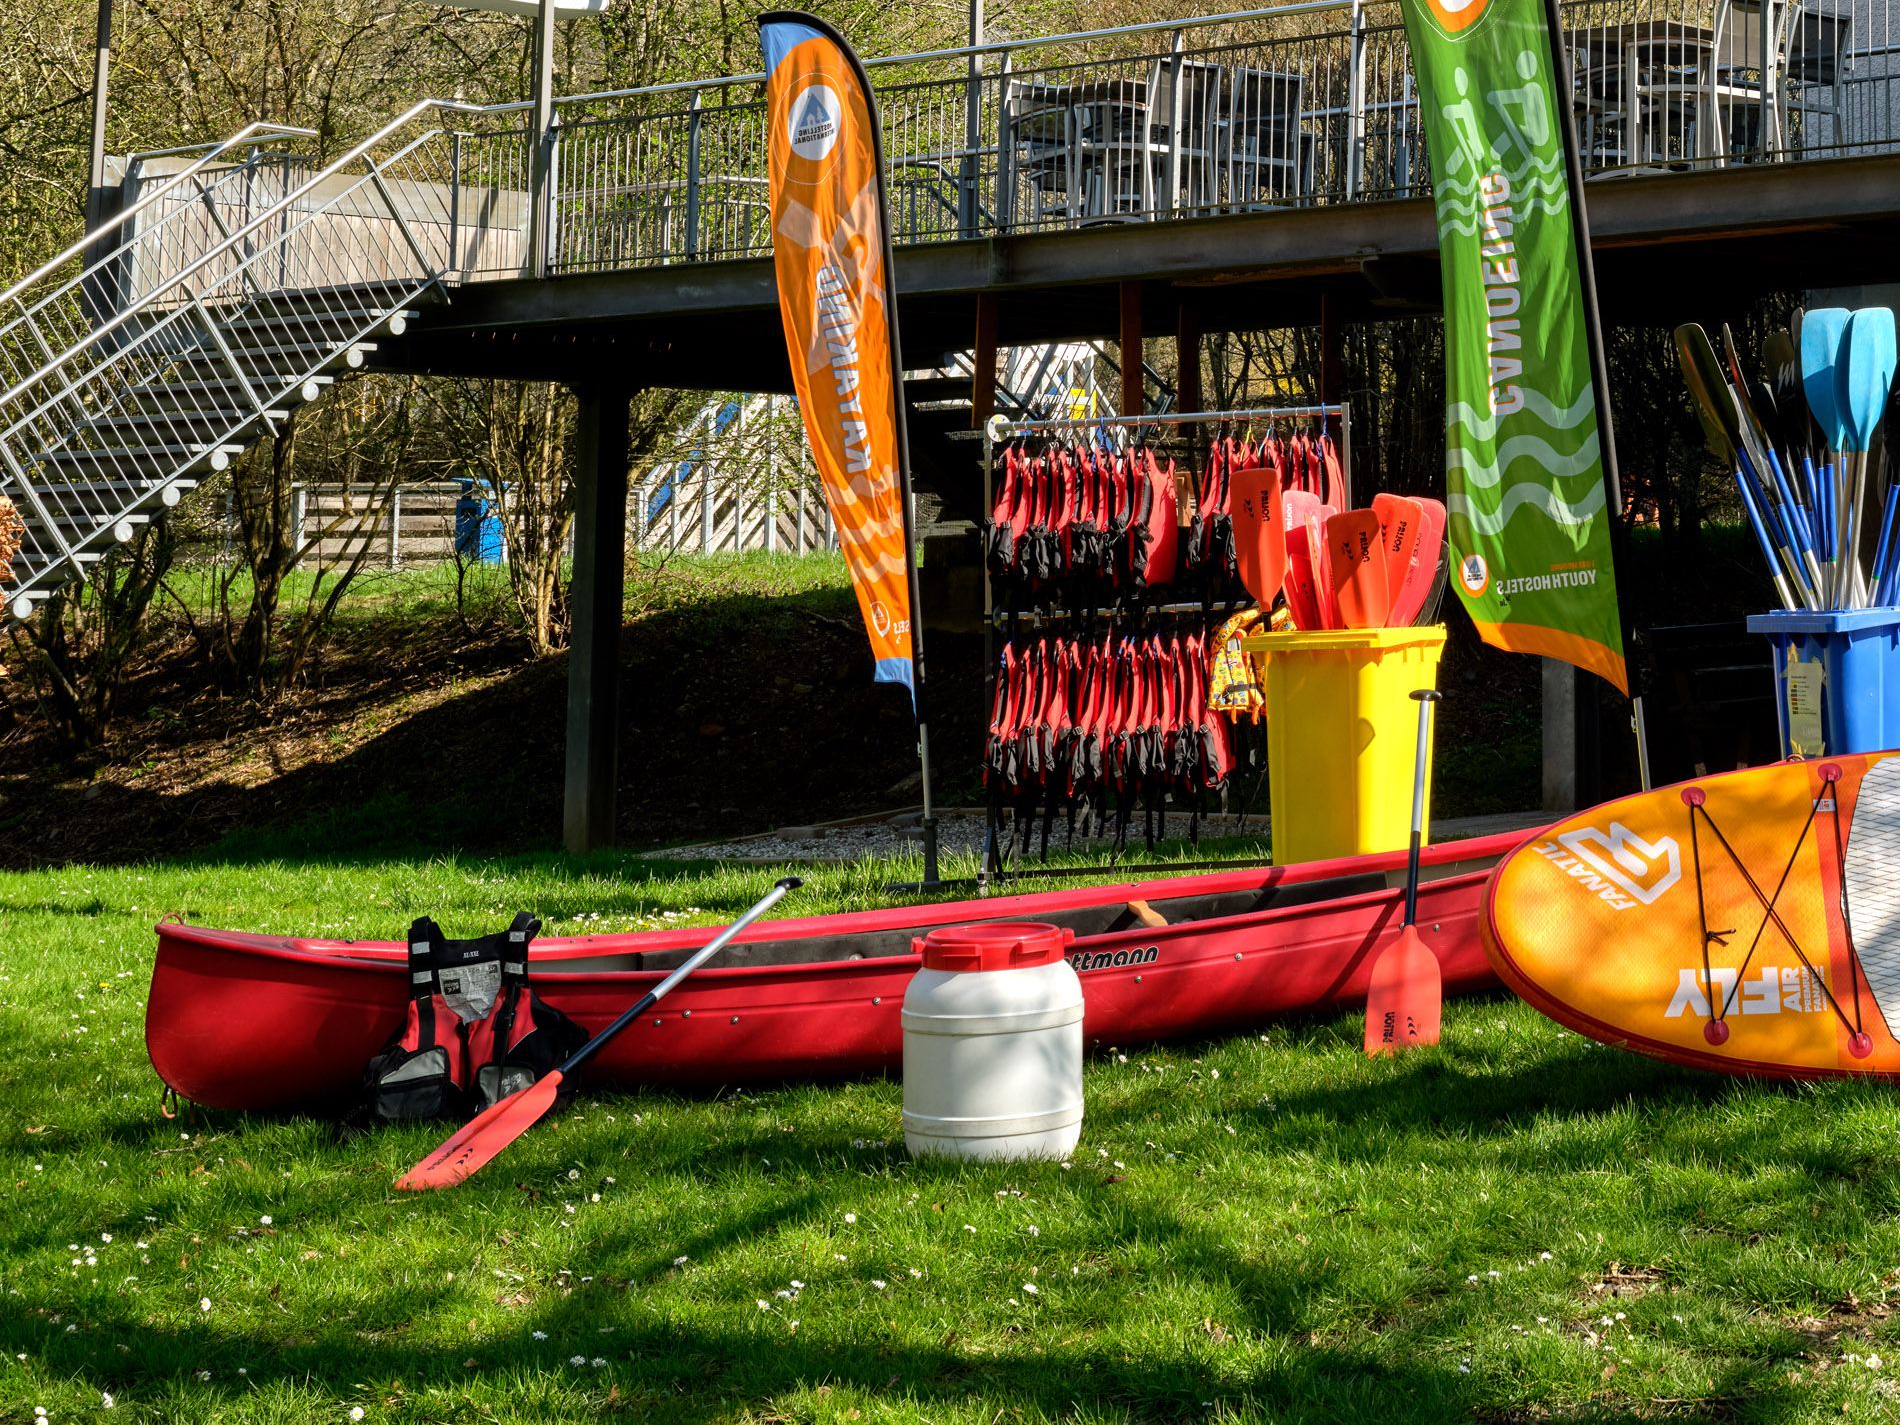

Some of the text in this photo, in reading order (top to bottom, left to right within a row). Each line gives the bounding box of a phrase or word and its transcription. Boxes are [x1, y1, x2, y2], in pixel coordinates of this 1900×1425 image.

[1532, 841, 1638, 911] FANATIC
[1664, 966, 1781, 1017] FLY
[1782, 966, 1803, 1013] AIR
[1801, 965, 1812, 1013] PREMIUM
